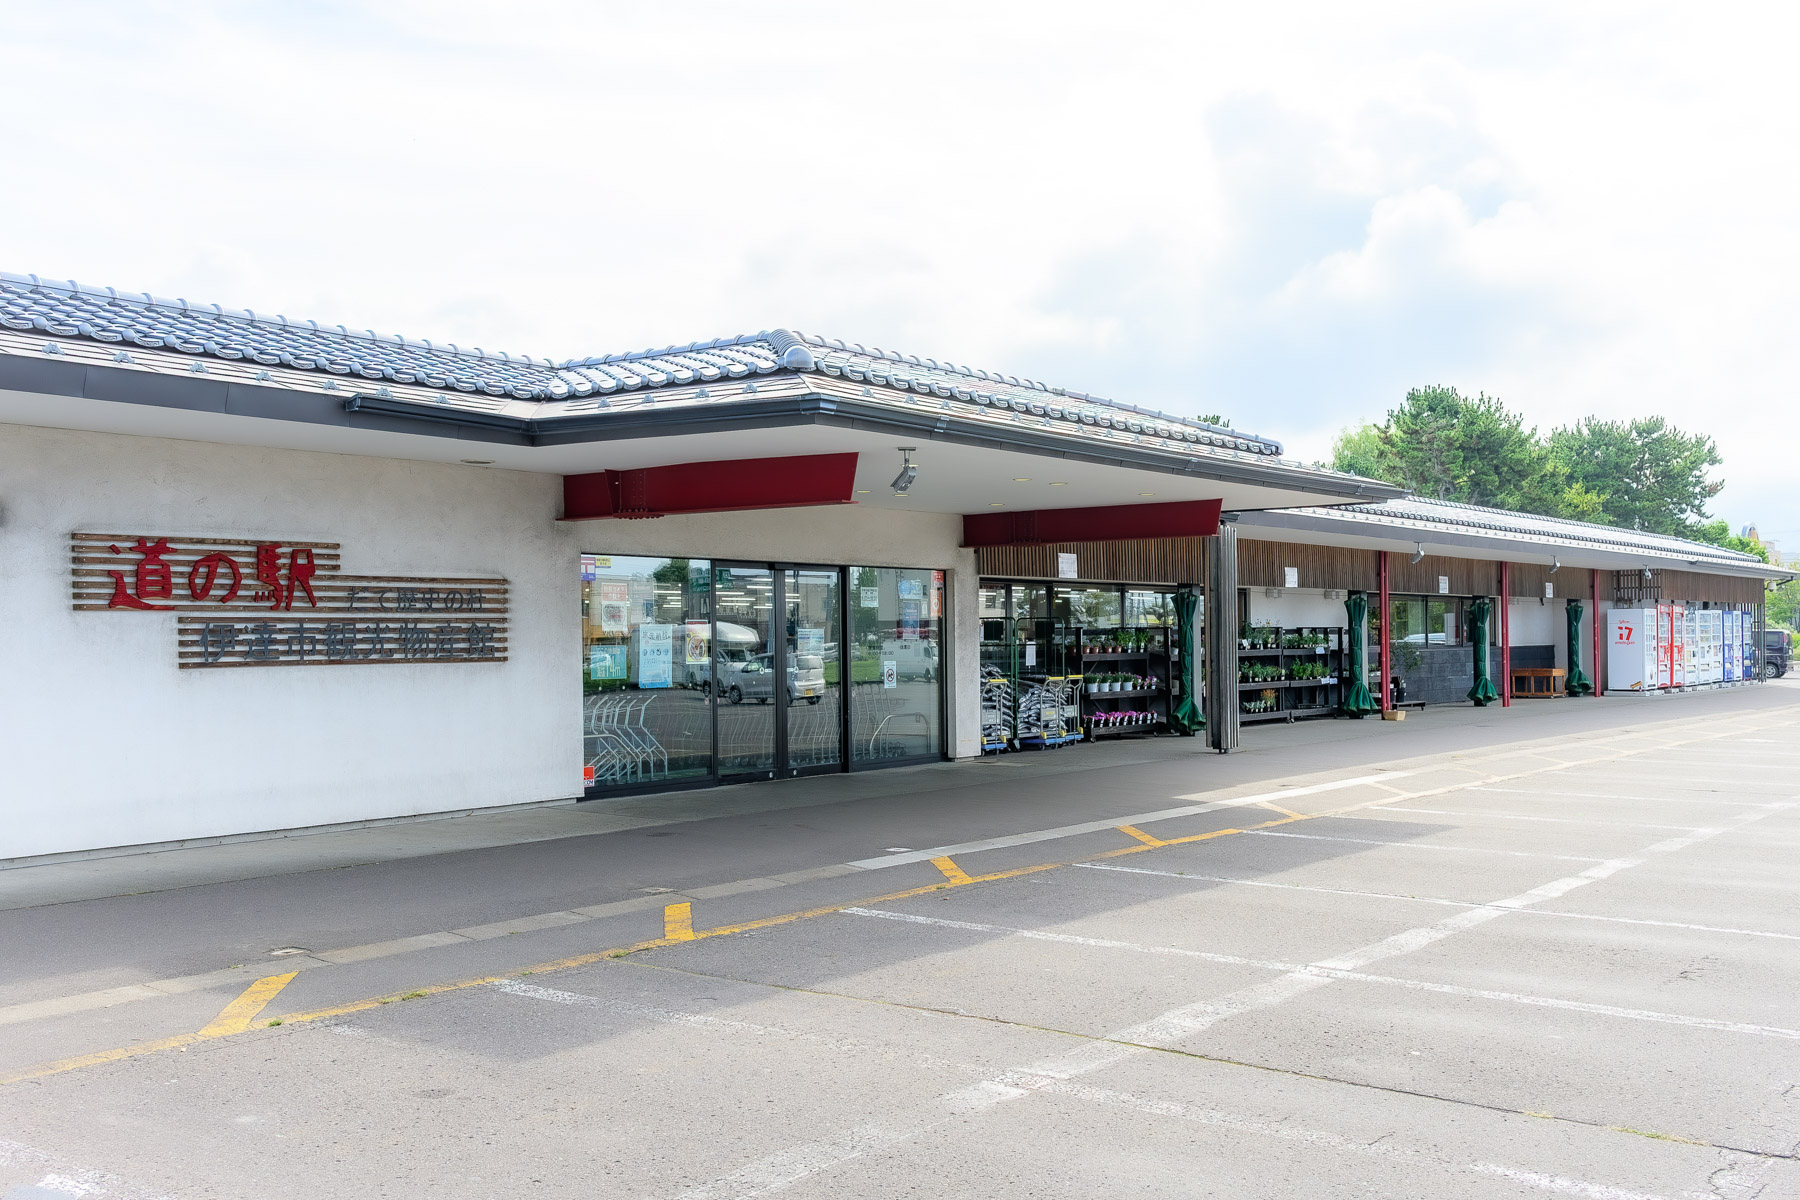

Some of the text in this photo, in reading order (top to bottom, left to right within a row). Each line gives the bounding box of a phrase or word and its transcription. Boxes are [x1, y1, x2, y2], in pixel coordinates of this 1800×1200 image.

[108, 538, 317, 610] 道の駅
[347, 586, 487, 613] だて歴史の杜
[200, 620, 497, 663] 伊達市観光物産館
